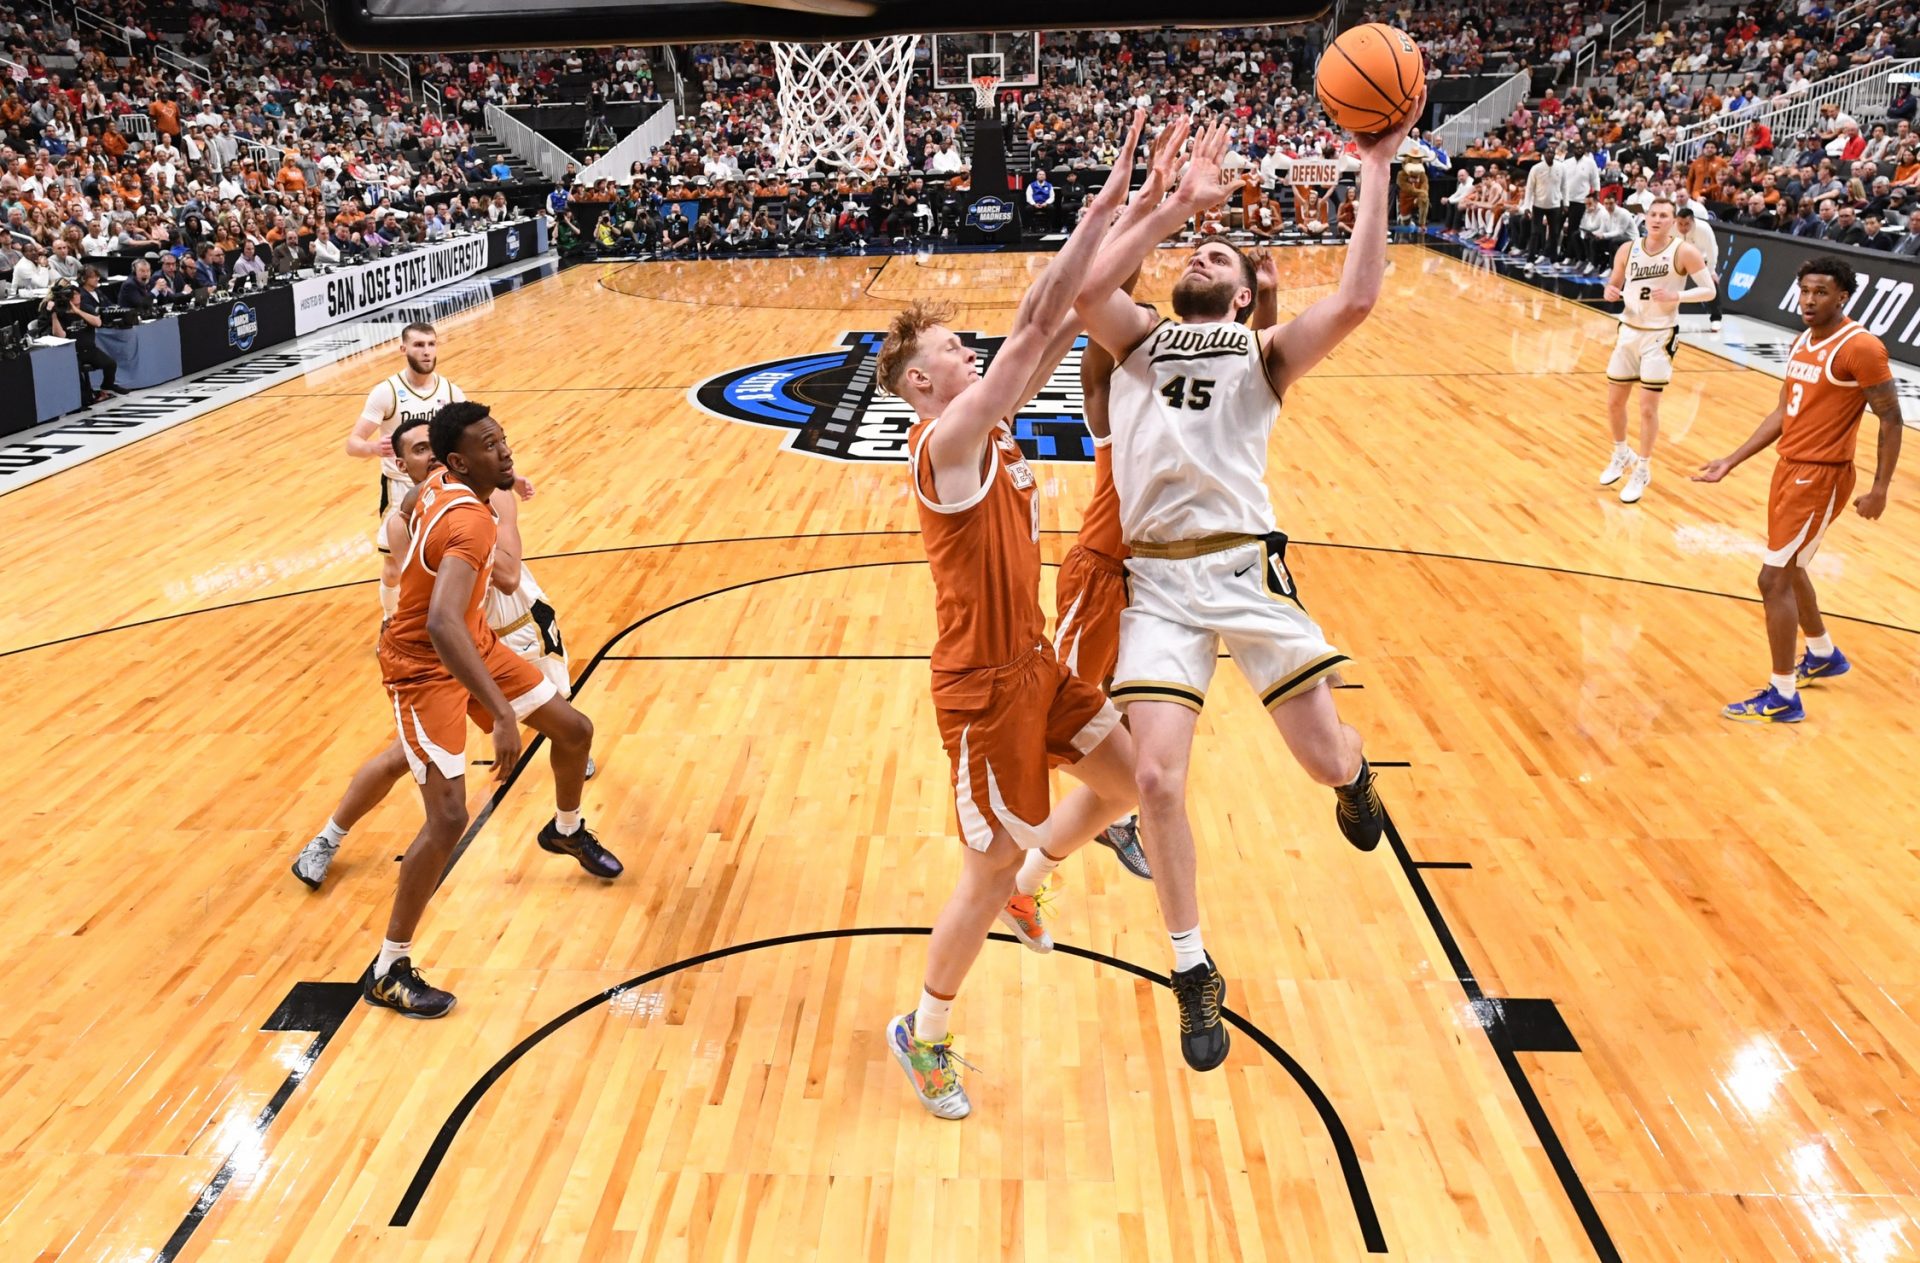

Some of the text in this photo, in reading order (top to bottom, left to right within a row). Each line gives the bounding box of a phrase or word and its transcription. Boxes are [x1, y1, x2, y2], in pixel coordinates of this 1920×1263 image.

[1292, 165, 1336, 182] DEFENSE
[980, 212, 1012, 221] MADNESS
[327, 239, 485, 318] SAN JOSE STATE UNIVERSITY
[1630, 262, 1670, 279] Purdue
[1730, 272, 1756, 289] NCAA
[1640, 287, 1651, 300] 2
[1858, 277, 1914, 336] TO
[1149, 327, 1249, 357] Purdue
[735, 372, 795, 393] ELITE
[1788, 360, 1823, 384] TEXAS
[1161, 375, 1216, 411] 45
[1787, 382, 1803, 417] 3
